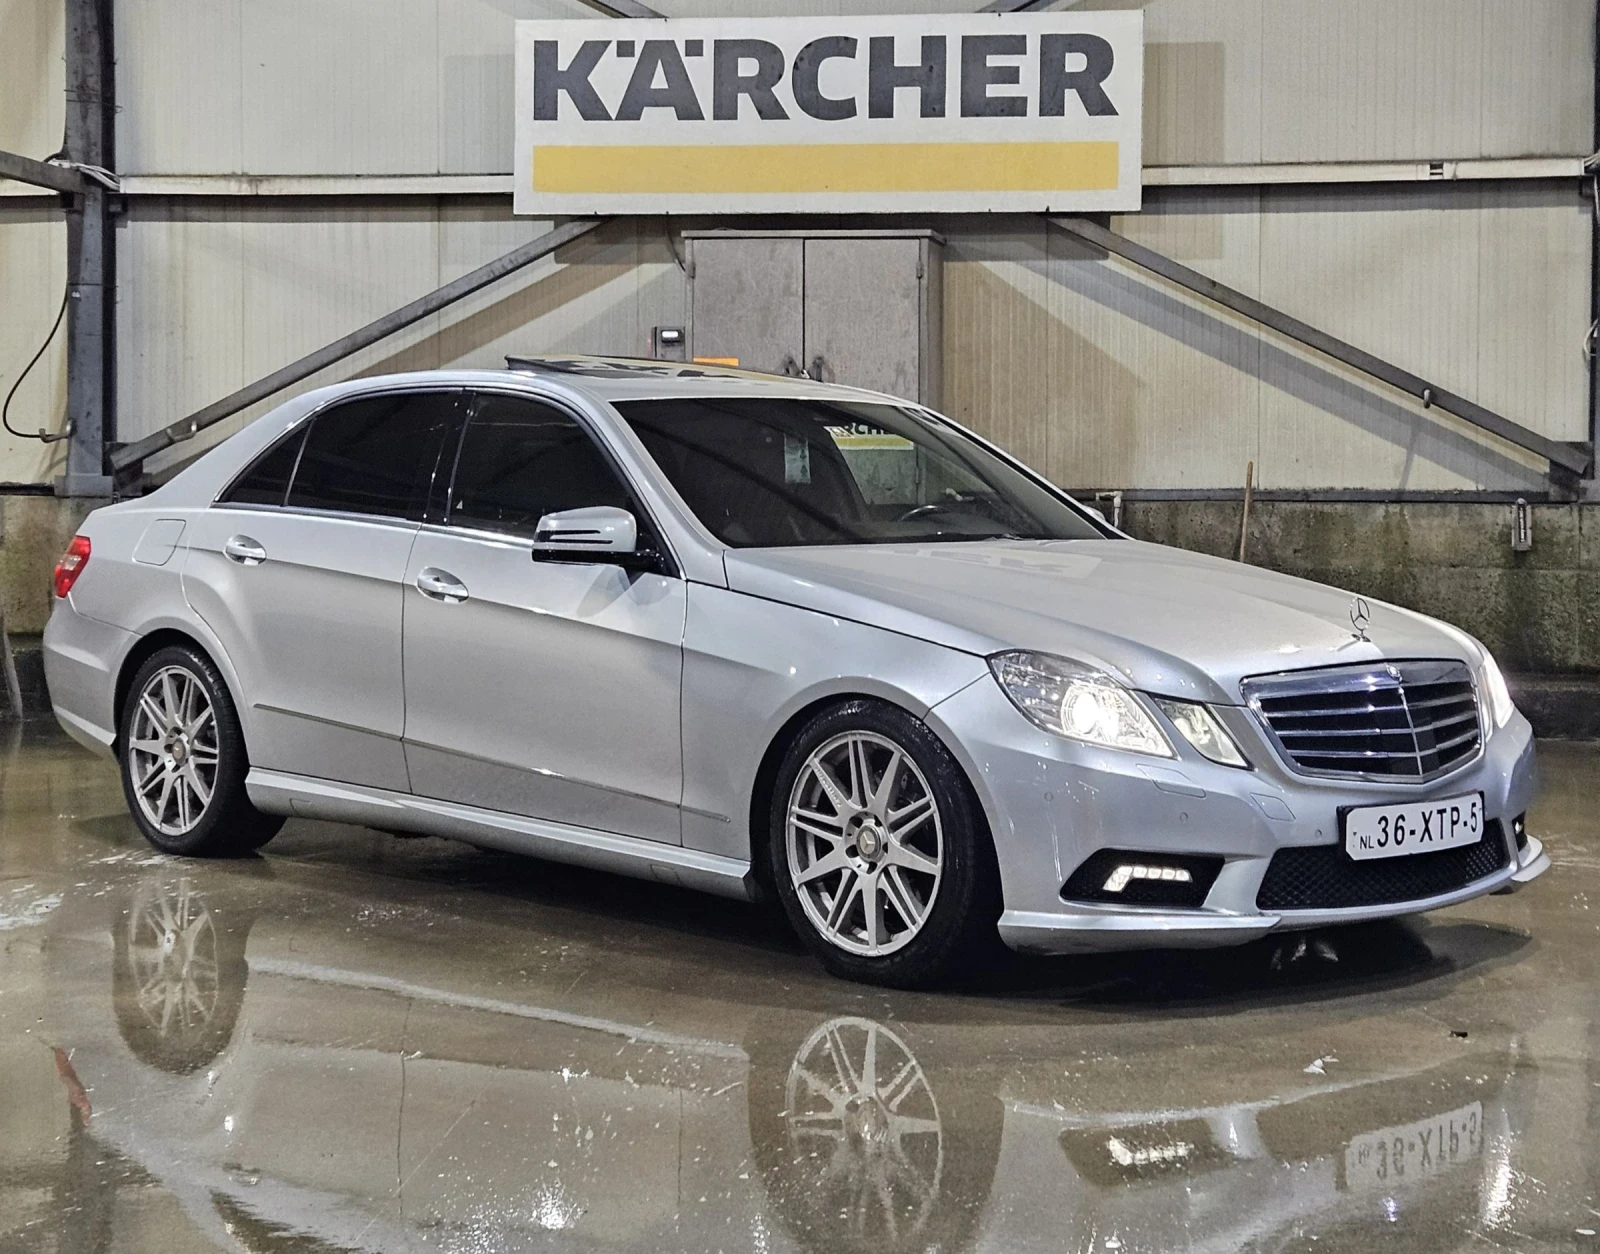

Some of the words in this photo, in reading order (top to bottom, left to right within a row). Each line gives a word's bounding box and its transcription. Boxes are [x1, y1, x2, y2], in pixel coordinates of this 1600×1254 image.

[533, 33, 1119, 121] KÄRCHER
[1359, 835, 1375, 850] NL
[1376, 801, 1477, 848] 36-XTP-5
